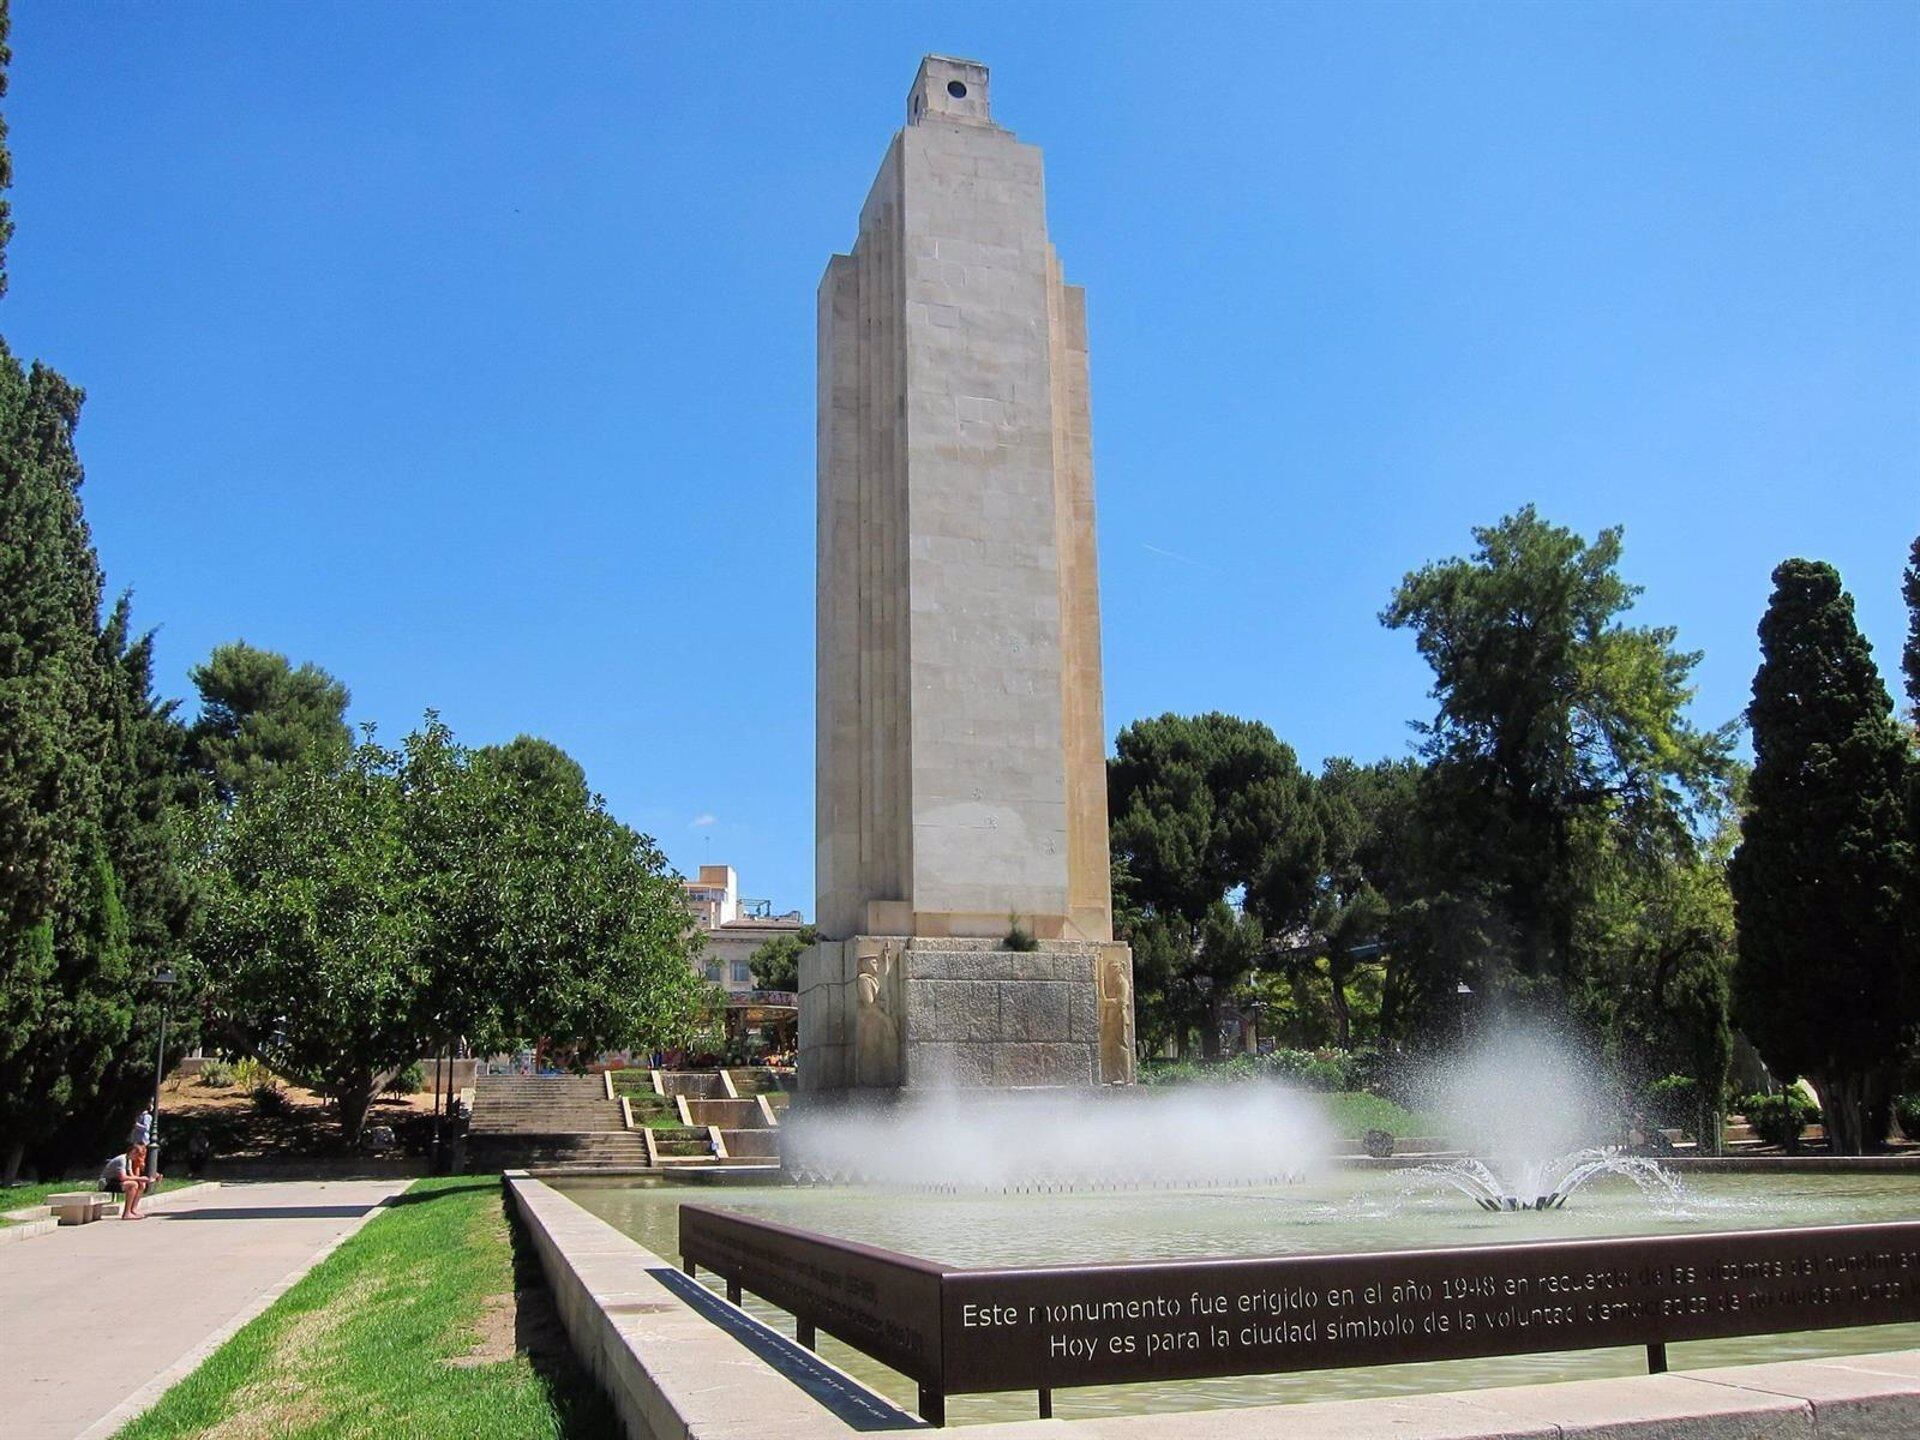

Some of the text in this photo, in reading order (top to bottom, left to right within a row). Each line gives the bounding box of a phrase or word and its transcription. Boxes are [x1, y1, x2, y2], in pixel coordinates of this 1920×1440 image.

[963, 1304, 1018, 1327] Este
[1029, 1296, 1181, 1324] monumento
[1190, 1291, 1228, 1315] fue
[1238, 1286, 1318, 1316] erigido
[1327, 1287, 1355, 1307] en
[1364, 1282, 1382, 1304] el
[1392, 1279, 1433, 1303] año
[1443, 1276, 1496, 1300] 1948
[1504, 1278, 1529, 1296] en
[1050, 1334, 1099, 1361] Hoy
[1109, 1335, 1136, 1353] es
[1146, 1331, 1200, 1357] para
[1211, 1325, 1230, 1347] la
[1240, 1318, 1317, 1345] ciudad
[1424, 1311, 1450, 1333] de
[1459, 1309, 1477, 1331] la
[1485, 1302, 1578, 1328] voluntad
